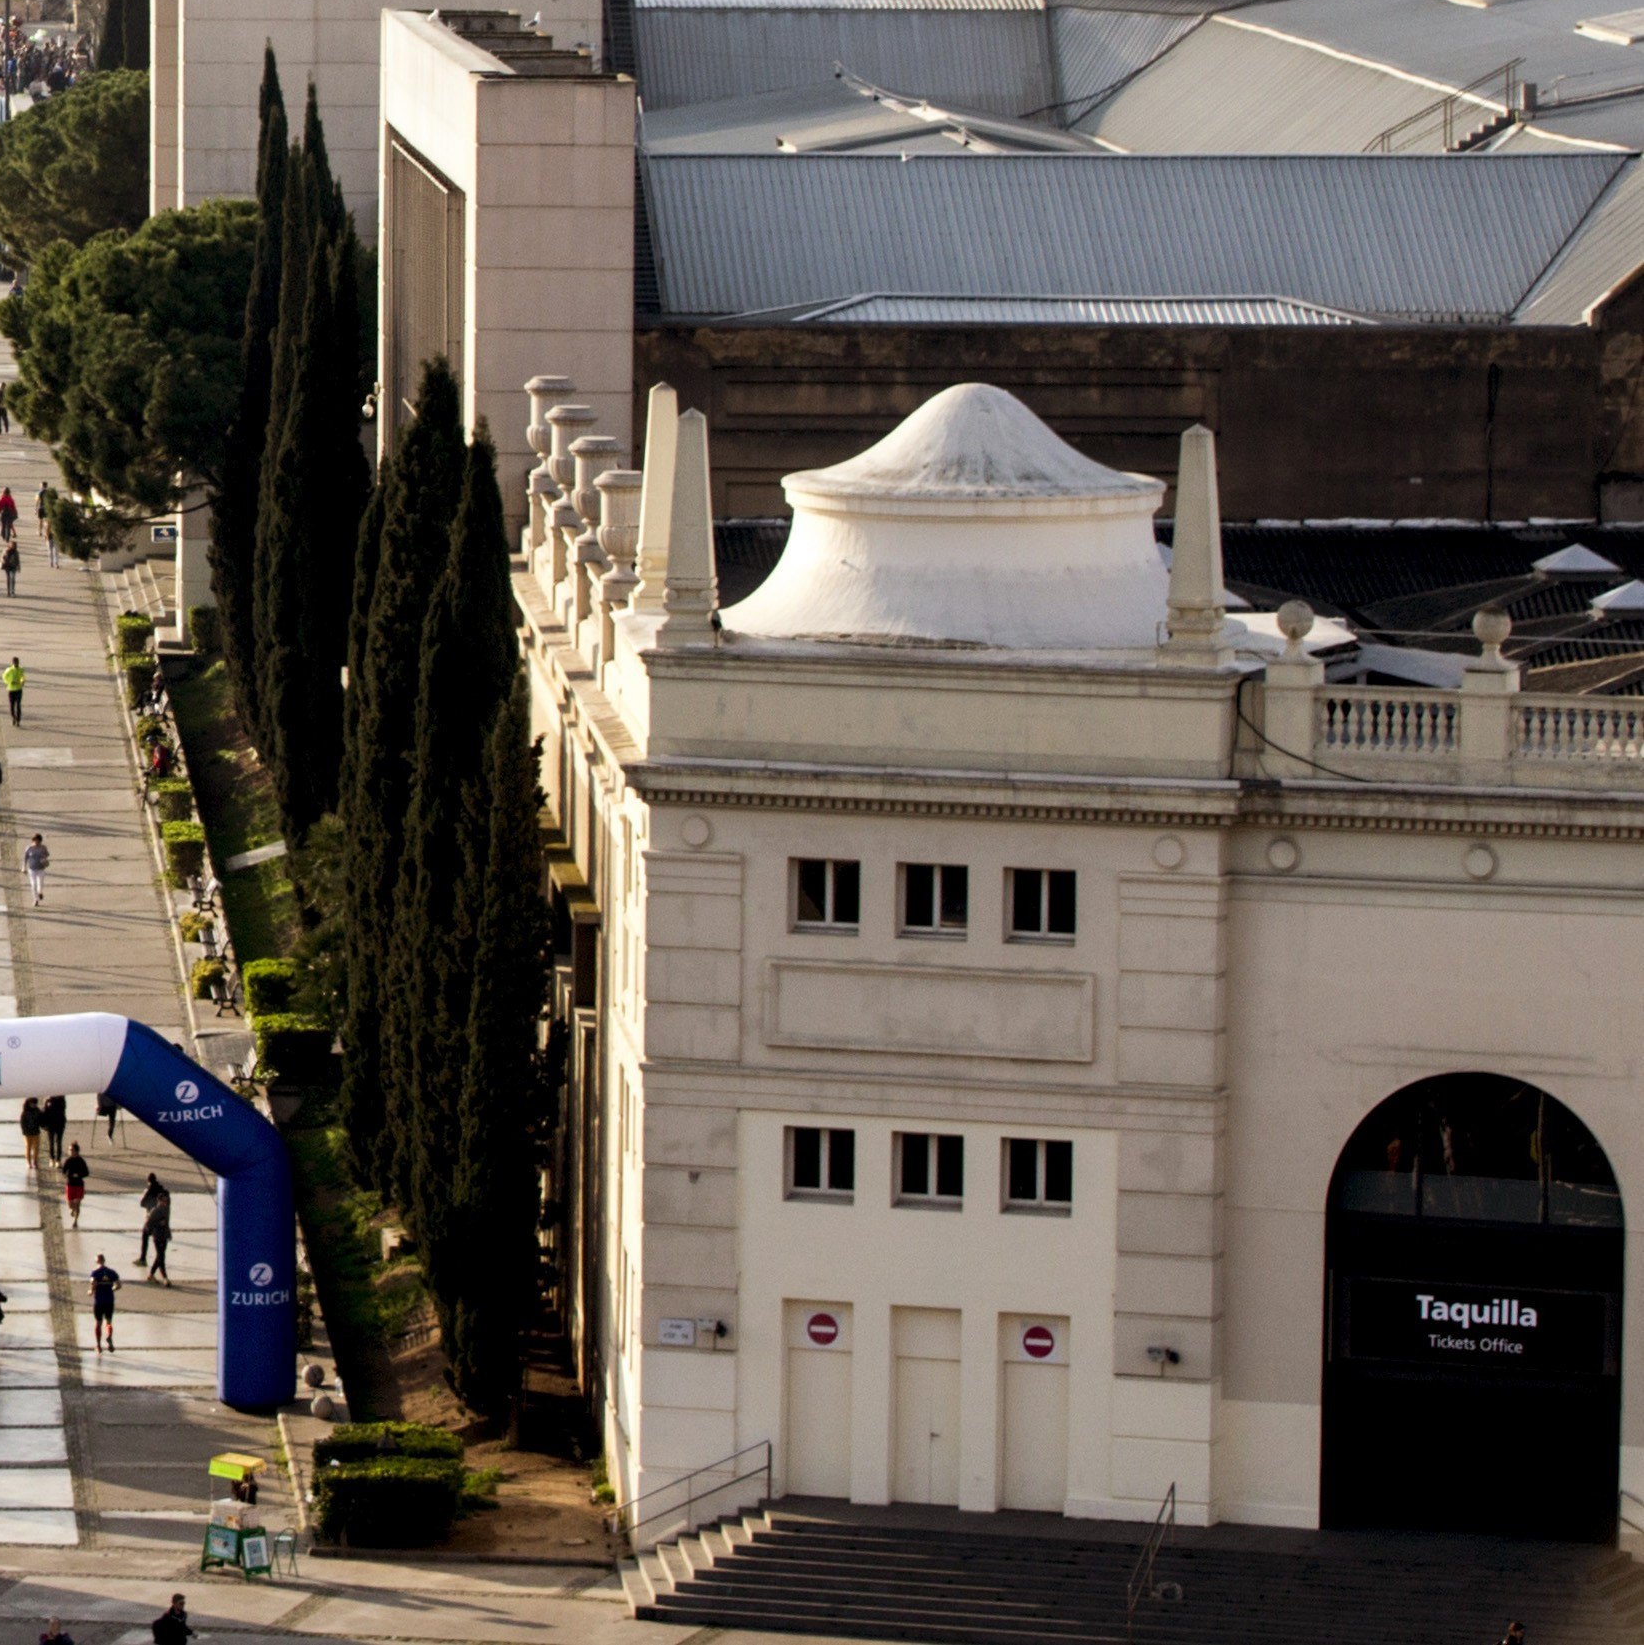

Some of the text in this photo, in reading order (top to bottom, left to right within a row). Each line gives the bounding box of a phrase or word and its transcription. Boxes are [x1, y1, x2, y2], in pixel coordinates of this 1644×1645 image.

[158, 1105, 224, 1123] ZURICH
[230, 1289, 290, 1306] ZURICH
[1416, 1294, 1537, 1329] Taquilla
[1428, 1334, 1523, 1354] Tickets Office
